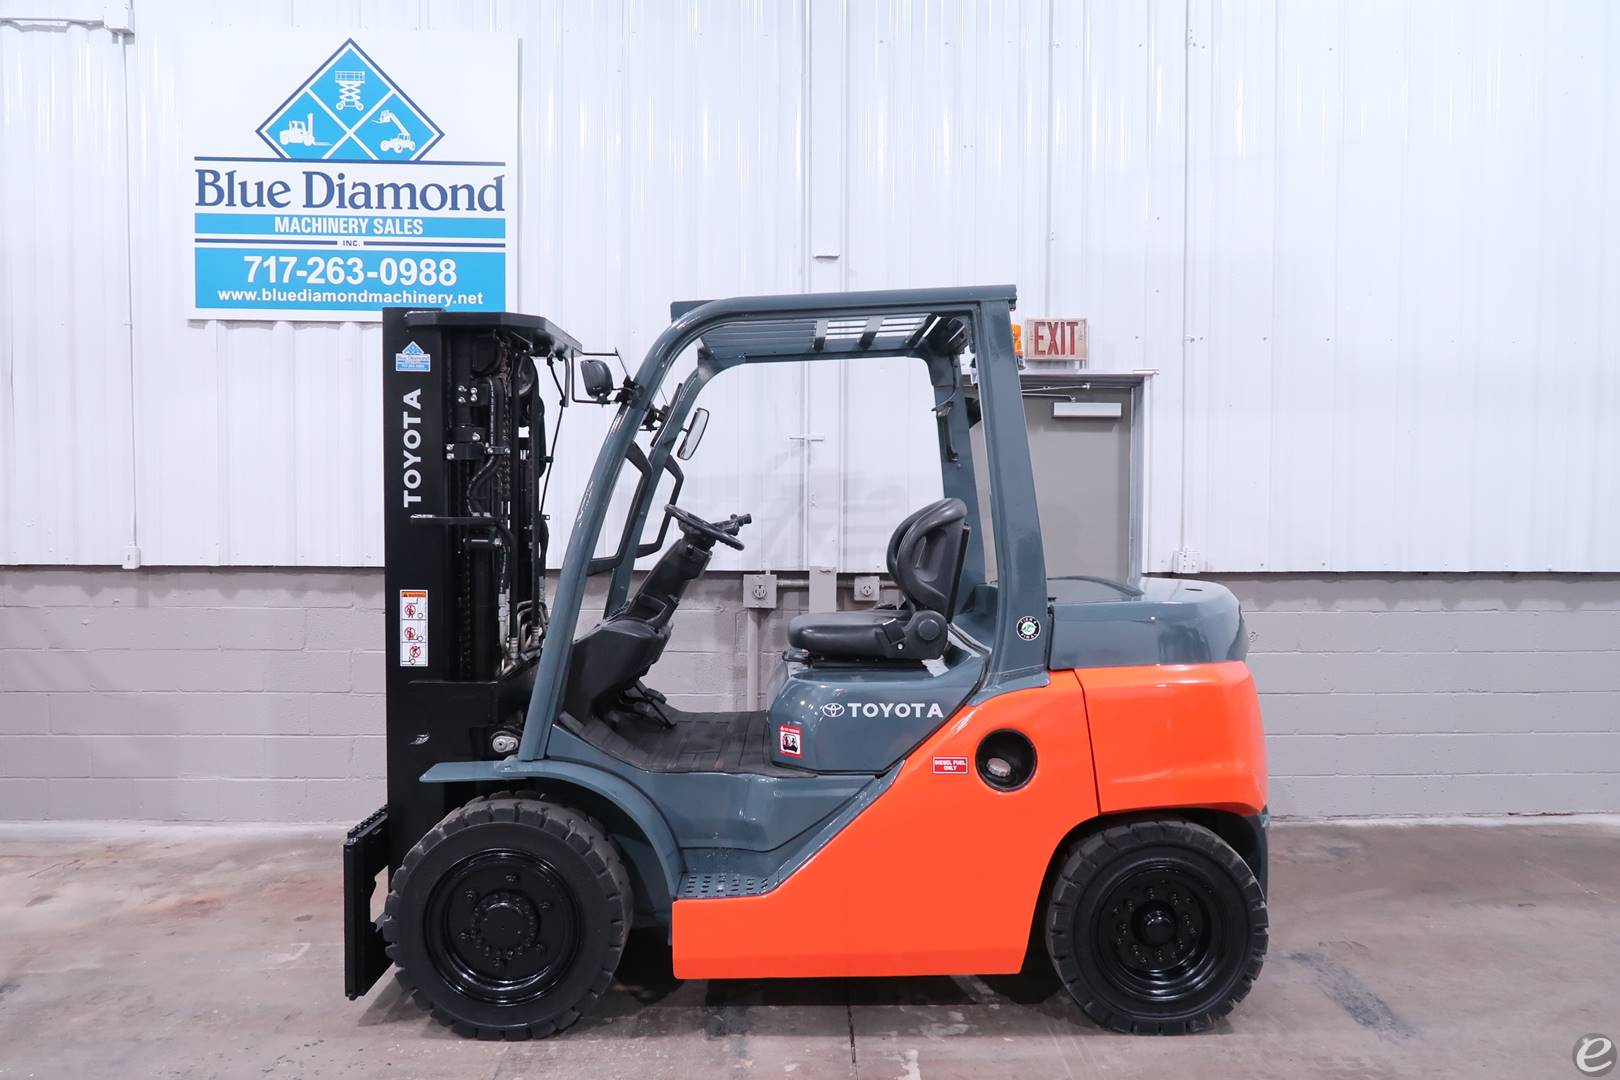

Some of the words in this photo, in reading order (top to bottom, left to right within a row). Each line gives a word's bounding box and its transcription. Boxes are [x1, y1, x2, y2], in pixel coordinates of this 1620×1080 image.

[195, 169, 291, 207] Blue
[302, 170, 505, 211] Diamond
[274, 216, 368, 234] MACHINERY
[373, 218, 424, 235] SALES
[342, 239, 361, 247] INC.
[243, 255, 457, 286] 717-263-0988
[217, 288, 484, 305] www.bluediamondmachinery.net
[1034, 321, 1079, 355] EXIT
[403, 388, 422, 508] TOYOTA
[847, 703, 944, 718] TOYOTA
